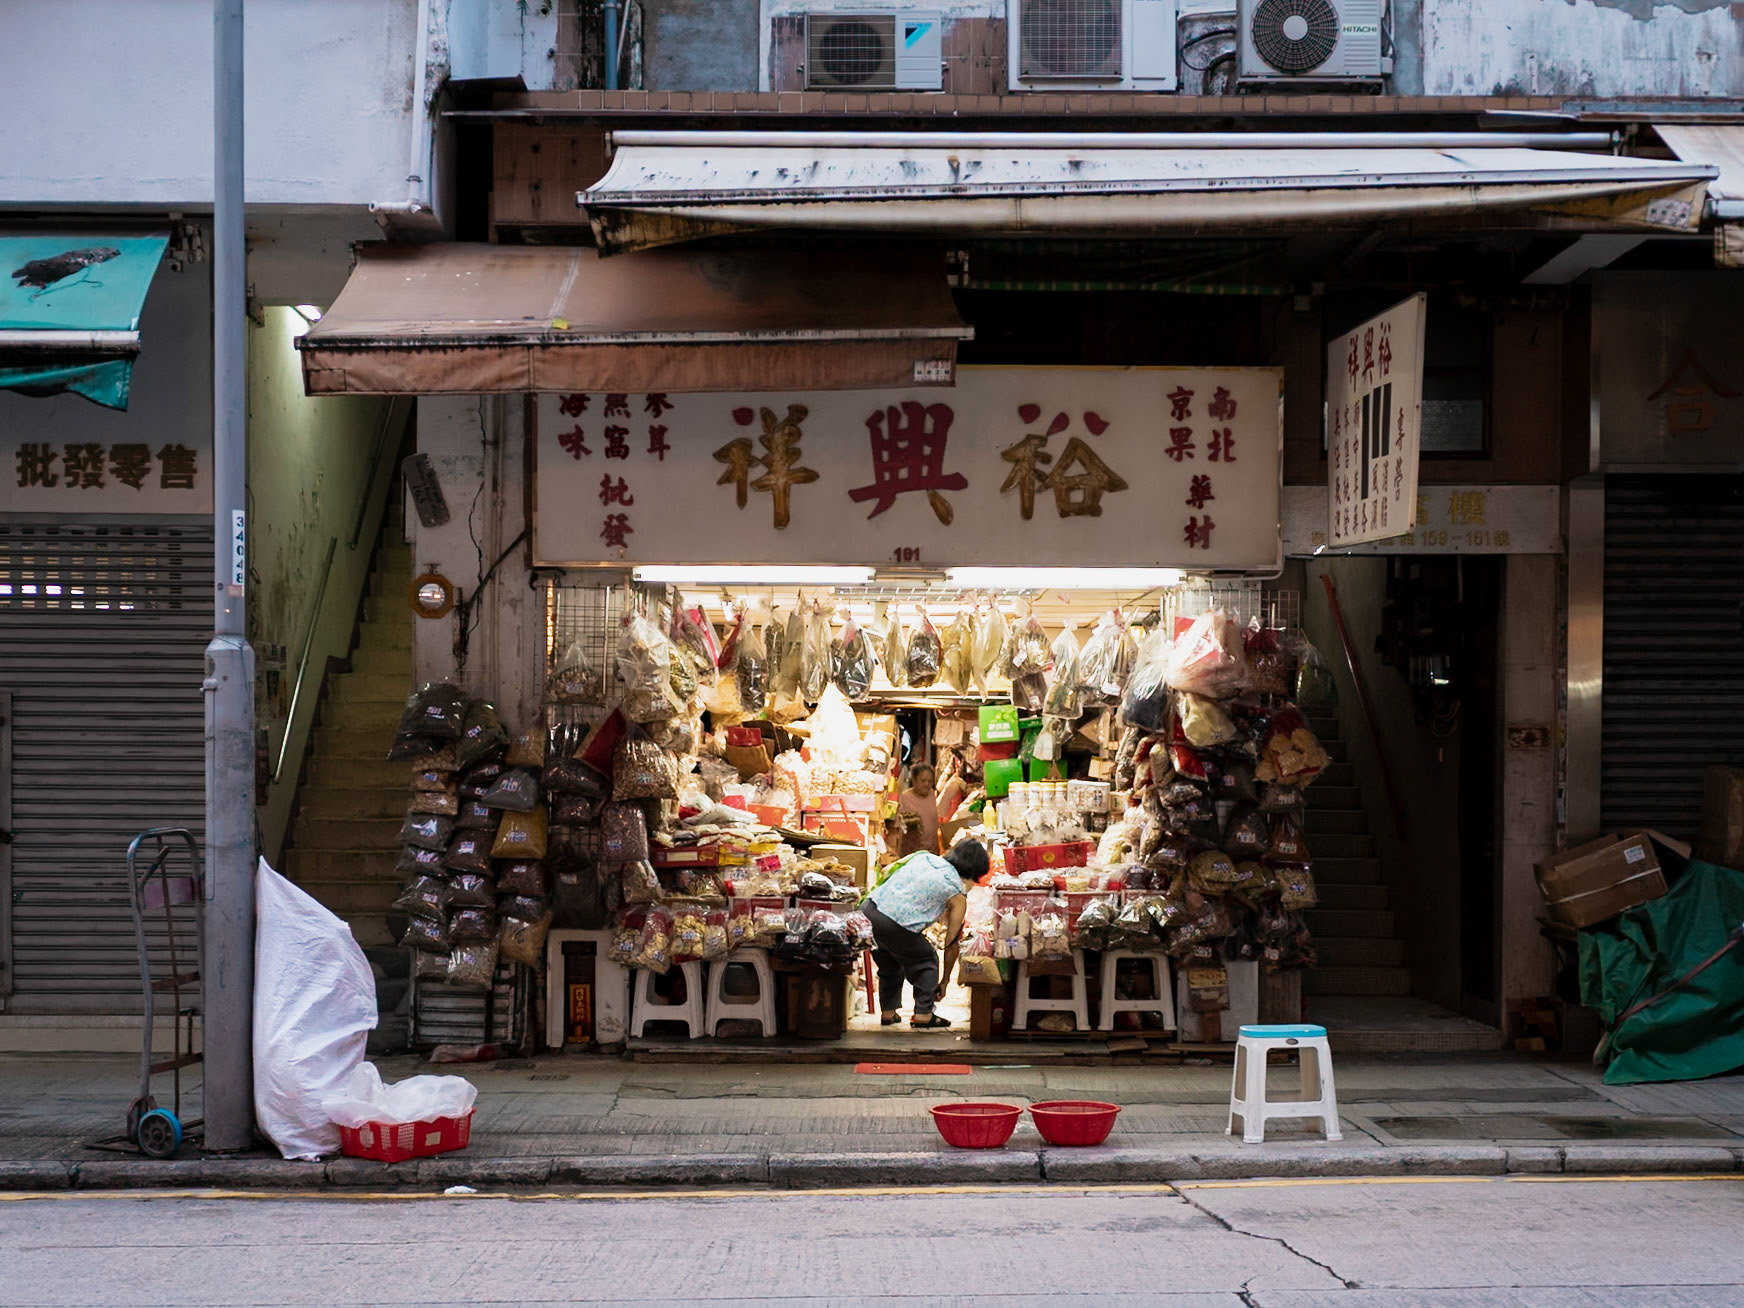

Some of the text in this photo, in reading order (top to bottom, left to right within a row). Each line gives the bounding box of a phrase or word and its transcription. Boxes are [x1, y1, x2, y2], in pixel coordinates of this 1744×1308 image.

[1342, 25, 1377, 33] HITACHI
[1347, 320, 1393, 393] 裕興祥
[557, 393, 593, 461] 海味
[1165, 386, 1196, 463] 京果
[1207, 386, 1238, 463] 南北
[16, 443, 198, 490] 批發零售
[598, 473, 634, 549] 批發
[1184, 474, 1216, 550] 藥材
[236, 516, 244, 584] 34048
